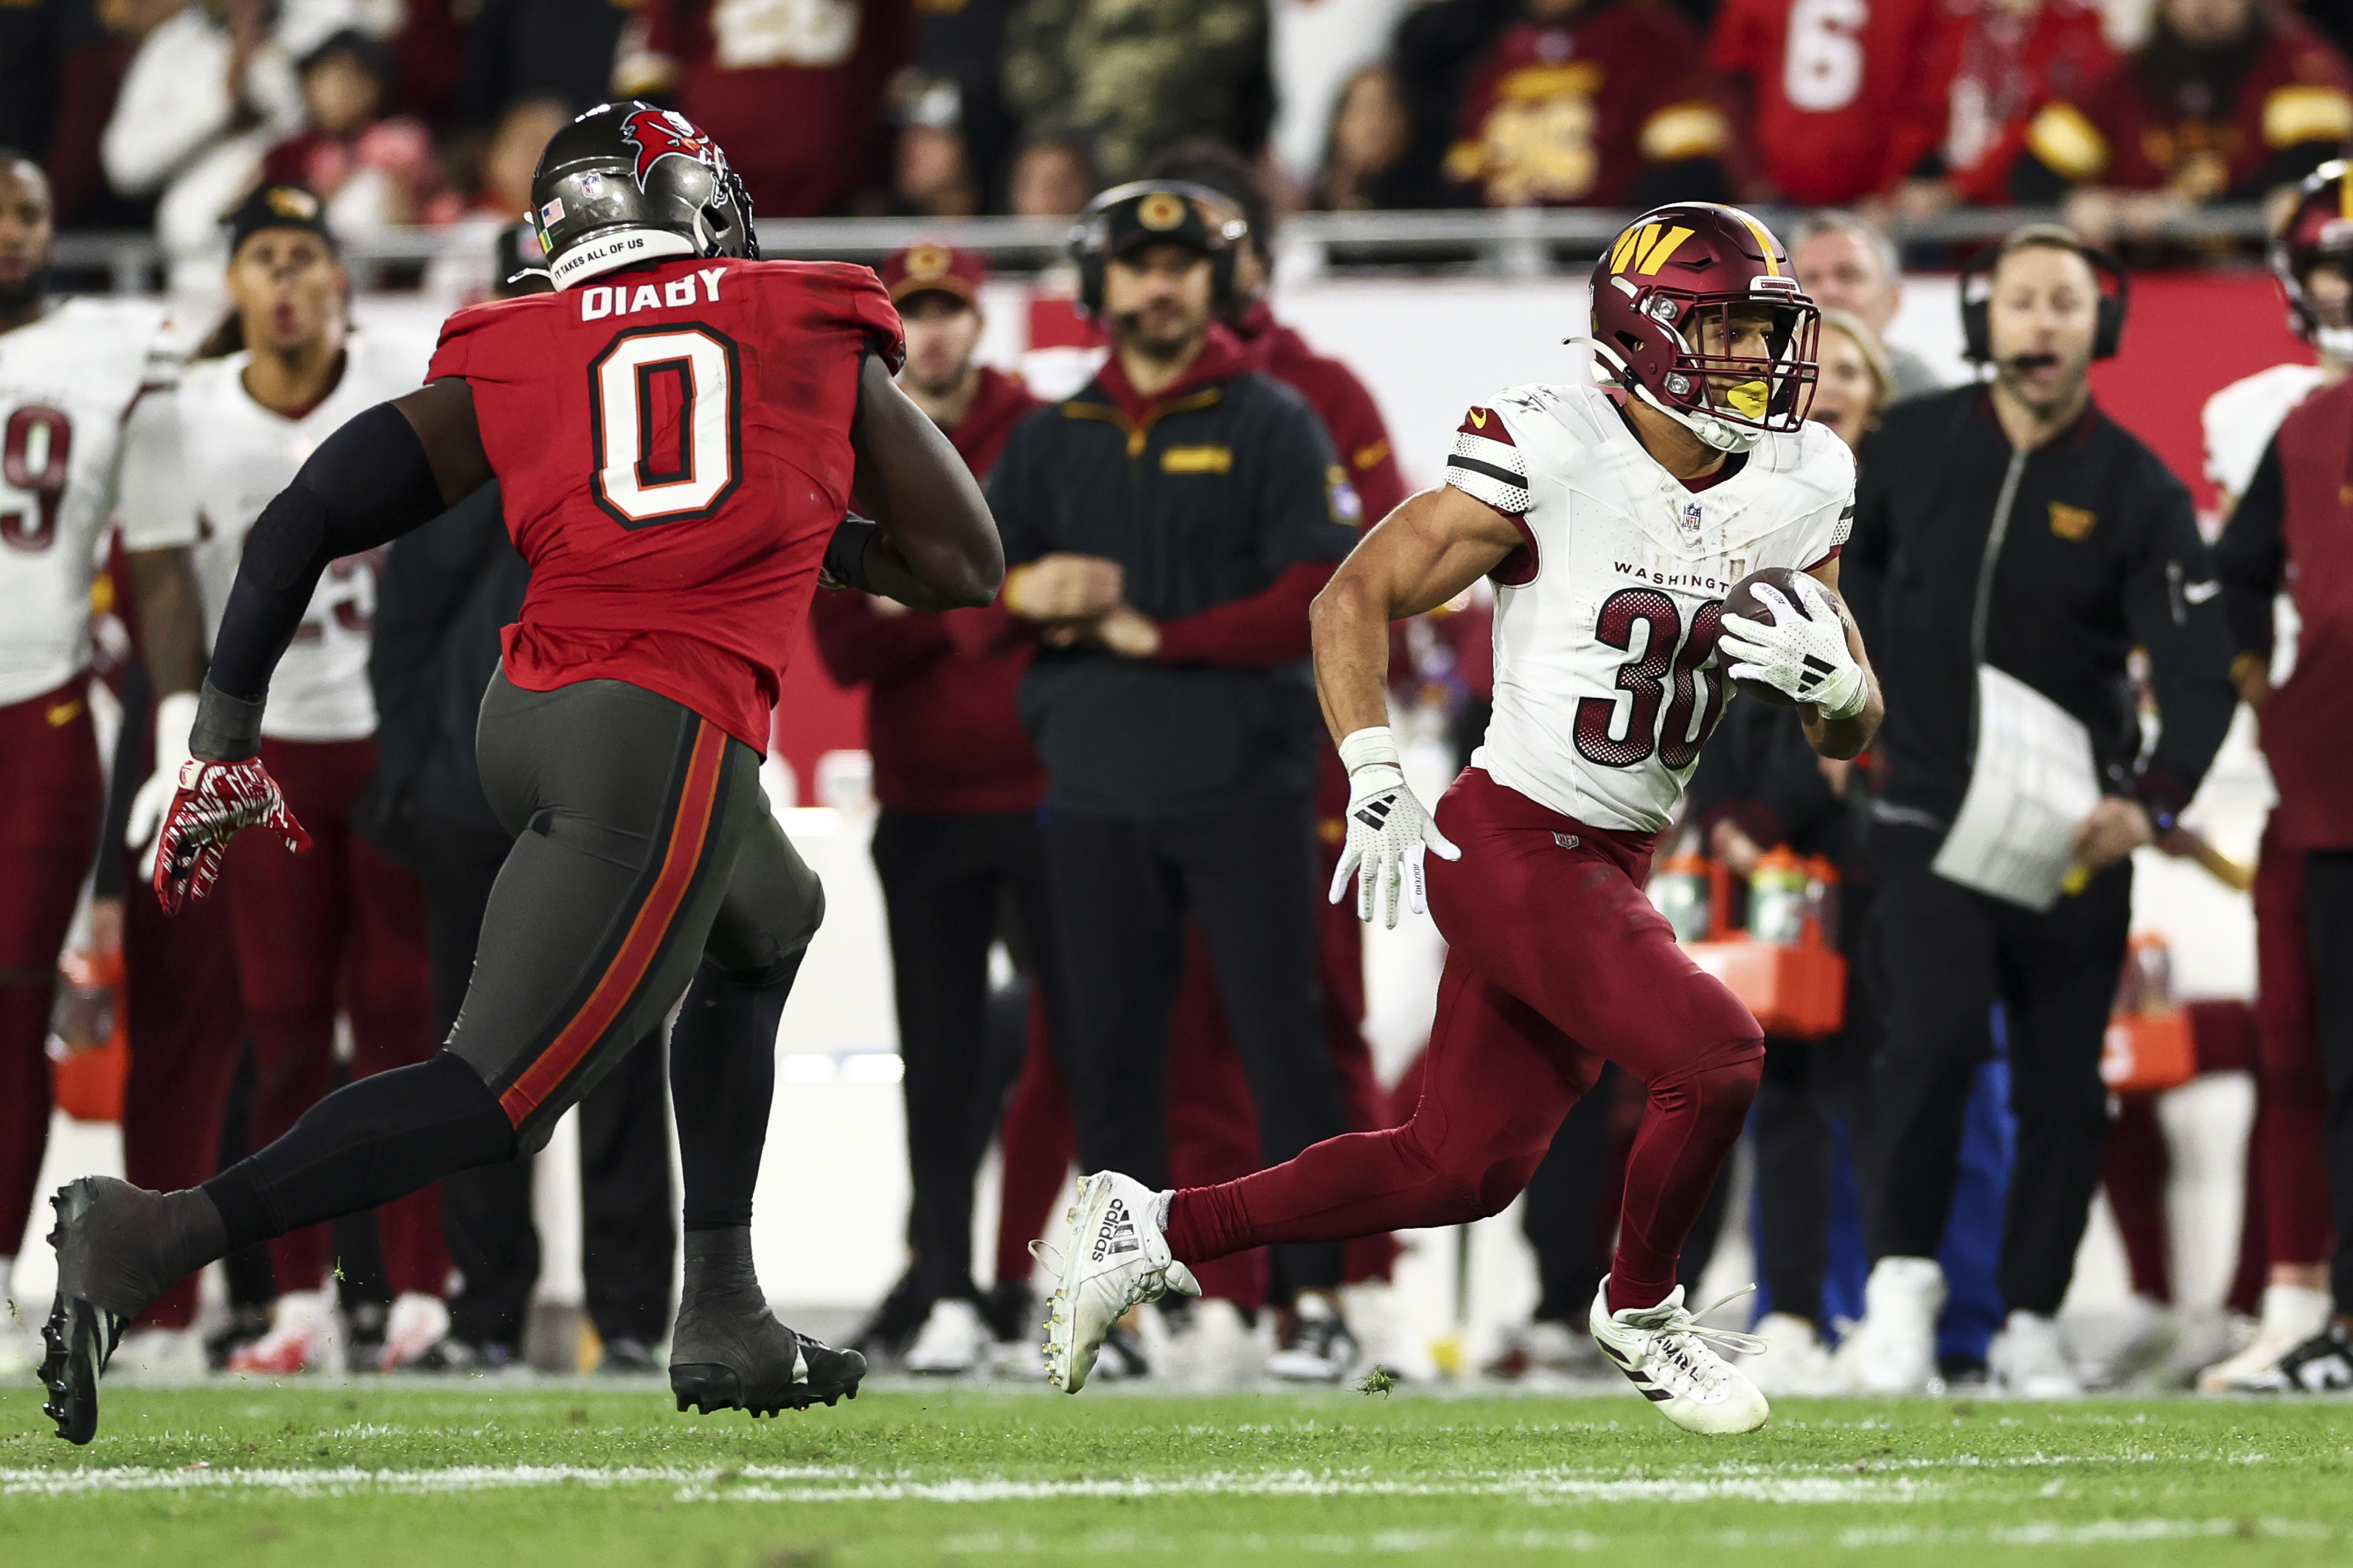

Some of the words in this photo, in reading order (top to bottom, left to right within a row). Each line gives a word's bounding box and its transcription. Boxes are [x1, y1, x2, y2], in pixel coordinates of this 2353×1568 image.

[1782, 0, 1871, 113] 6
[555, 270, 562, 281] IT
[561, 256, 585, 274] TAKES
[587, 248, 608, 262] ALL
[609, 243, 625, 254] OF
[628, 238, 644, 249] US
[582, 266, 728, 322] DIABY
[587, 320, 743, 531] 0
[1684, 515, 1699, 529] NFL
[1614, 562, 1729, 593] WASHINGT
[1759, 584, 1785, 604] ADIZERO
[1572, 587, 1724, 770] 30
[1559, 834, 1577, 845] NFL
[1413, 863, 1422, 895] ADIZERO
[1091, 1199, 1123, 1262] adidas
